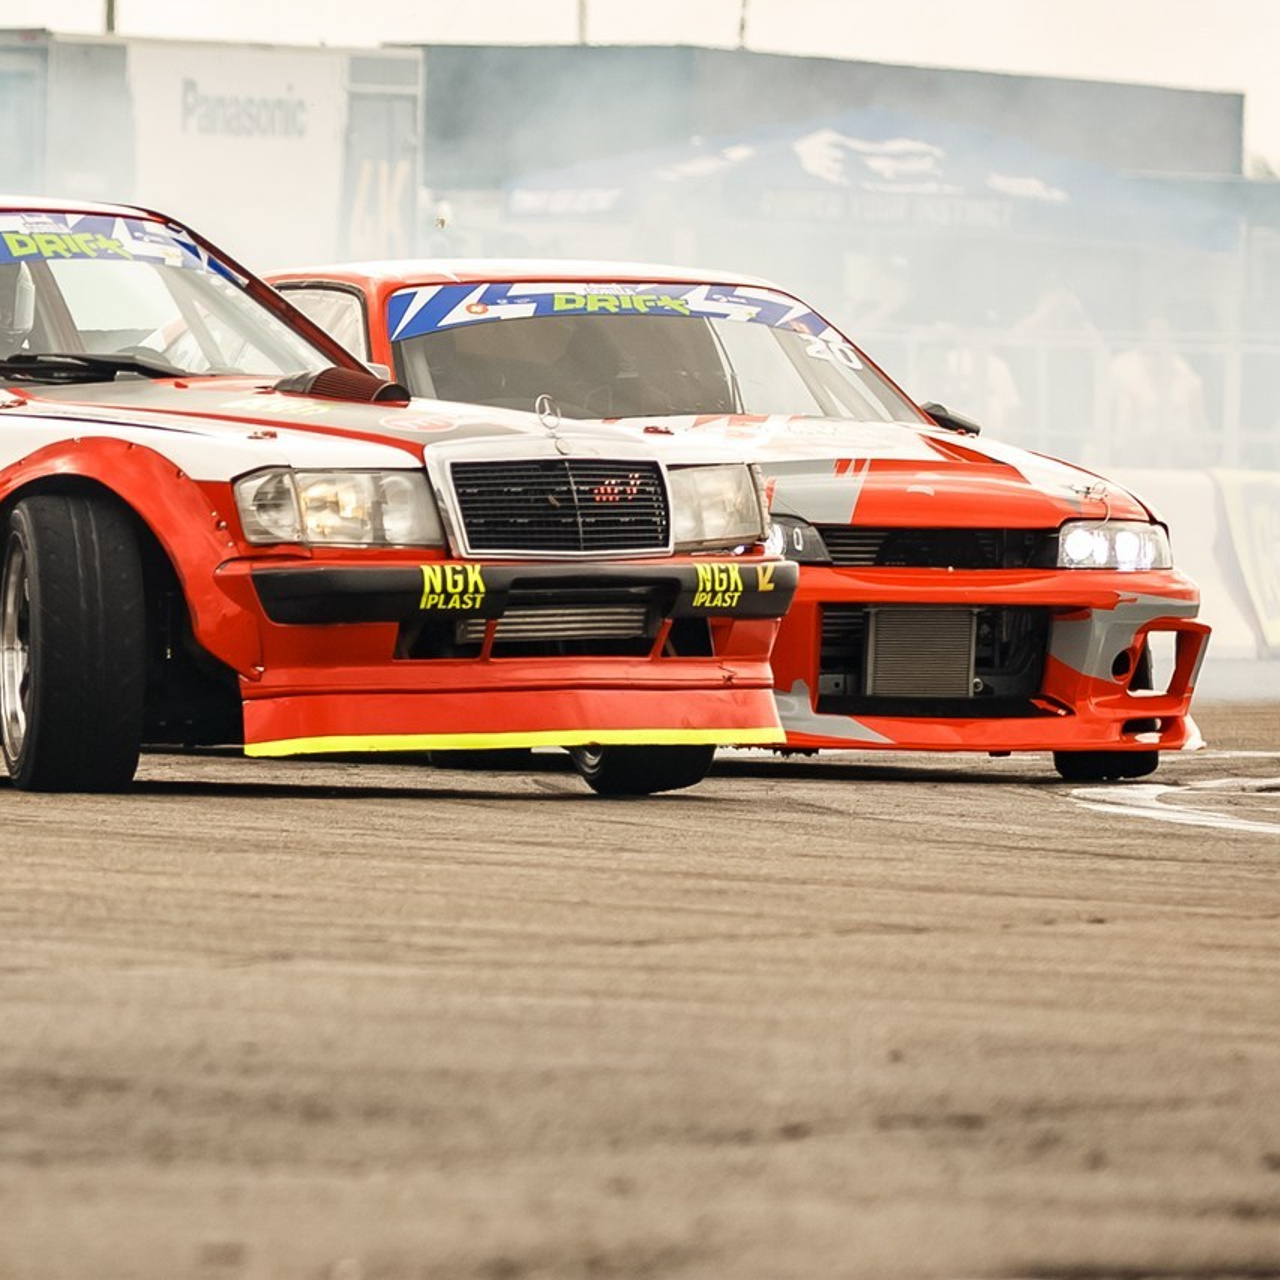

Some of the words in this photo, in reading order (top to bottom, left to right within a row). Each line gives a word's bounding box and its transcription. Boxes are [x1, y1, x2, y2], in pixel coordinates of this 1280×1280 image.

[182, 77, 307, 137] Panasonic
[420, 564, 486, 594] NGK
[694, 563, 743, 592] NGK
